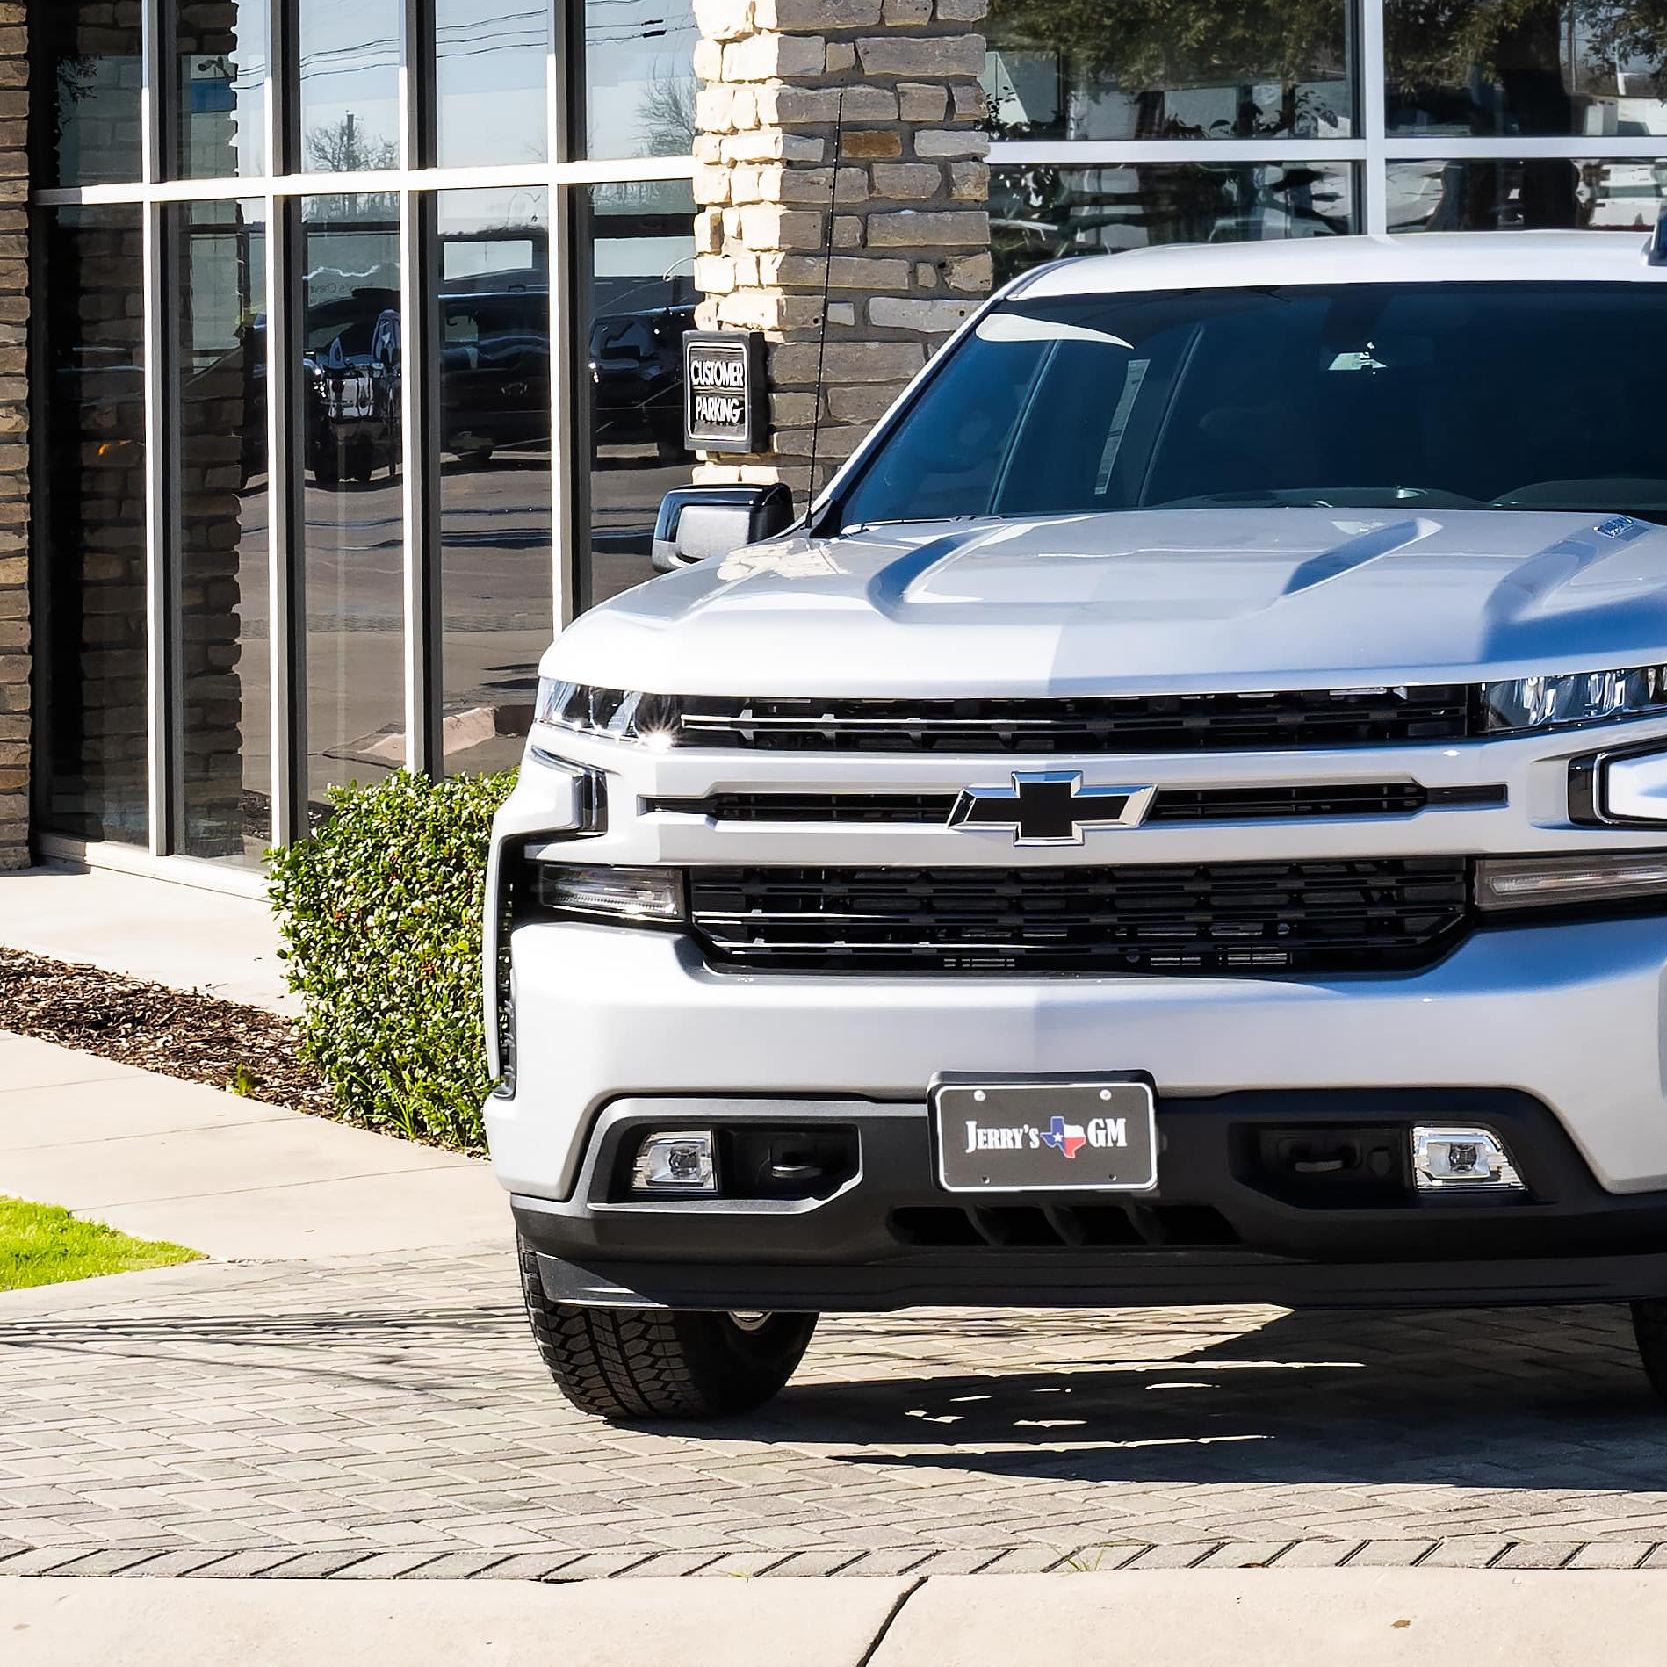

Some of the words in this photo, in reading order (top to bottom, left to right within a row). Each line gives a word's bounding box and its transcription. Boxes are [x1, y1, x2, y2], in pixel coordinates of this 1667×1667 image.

[690, 361, 743, 387] CUSTOMER
[696, 396, 744, 423] PARKING
[1087, 1117, 1128, 1148] GM
